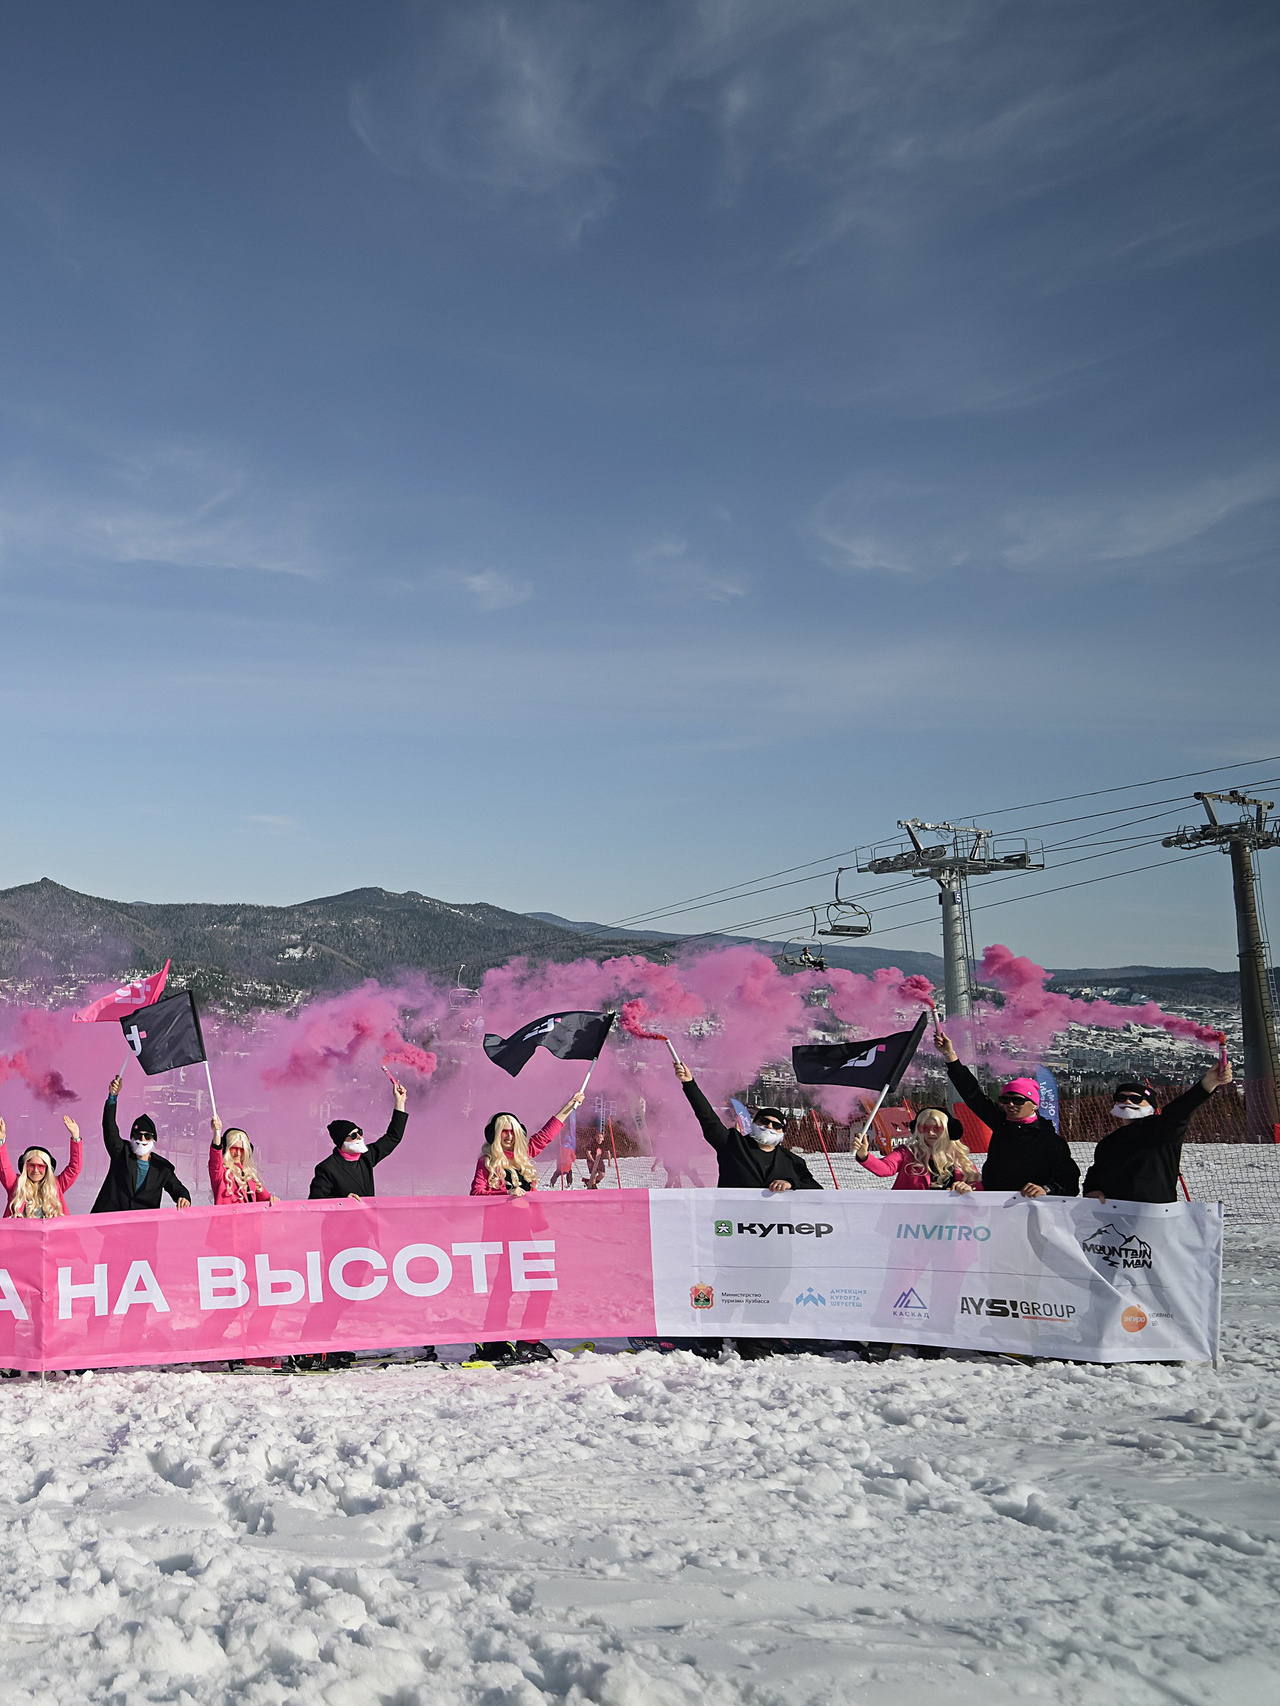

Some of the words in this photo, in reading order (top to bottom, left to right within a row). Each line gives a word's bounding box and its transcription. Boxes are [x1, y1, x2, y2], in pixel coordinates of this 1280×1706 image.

[896, 1223, 992, 1242] INVITRO
[1082, 1242, 1151, 1259] MOUNTAIN
[1123, 1259, 1152, 1269] MAN
[58, 1260, 171, 1320] НА
[197, 1239, 559, 1310] ВЫСОТЕ
[892, 1311, 930, 1319] КАСКАД
